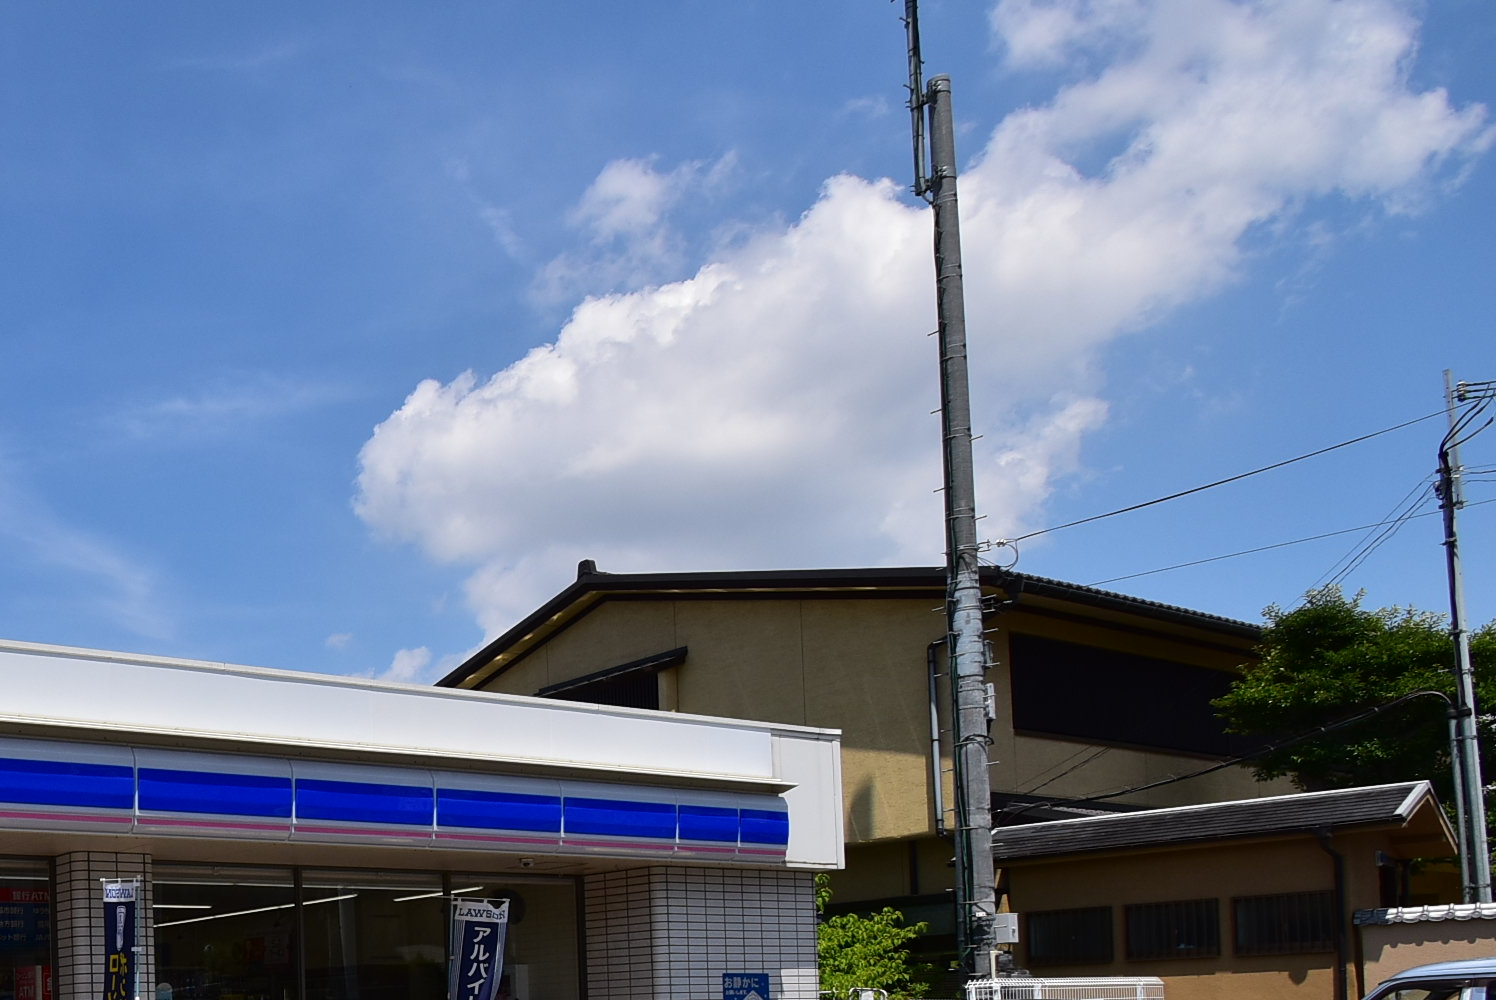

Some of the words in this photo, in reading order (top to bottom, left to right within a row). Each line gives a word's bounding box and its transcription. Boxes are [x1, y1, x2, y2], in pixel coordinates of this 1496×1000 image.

[459, 908, 506, 921] LAWSON
[724, 976, 759, 989] お静かに
